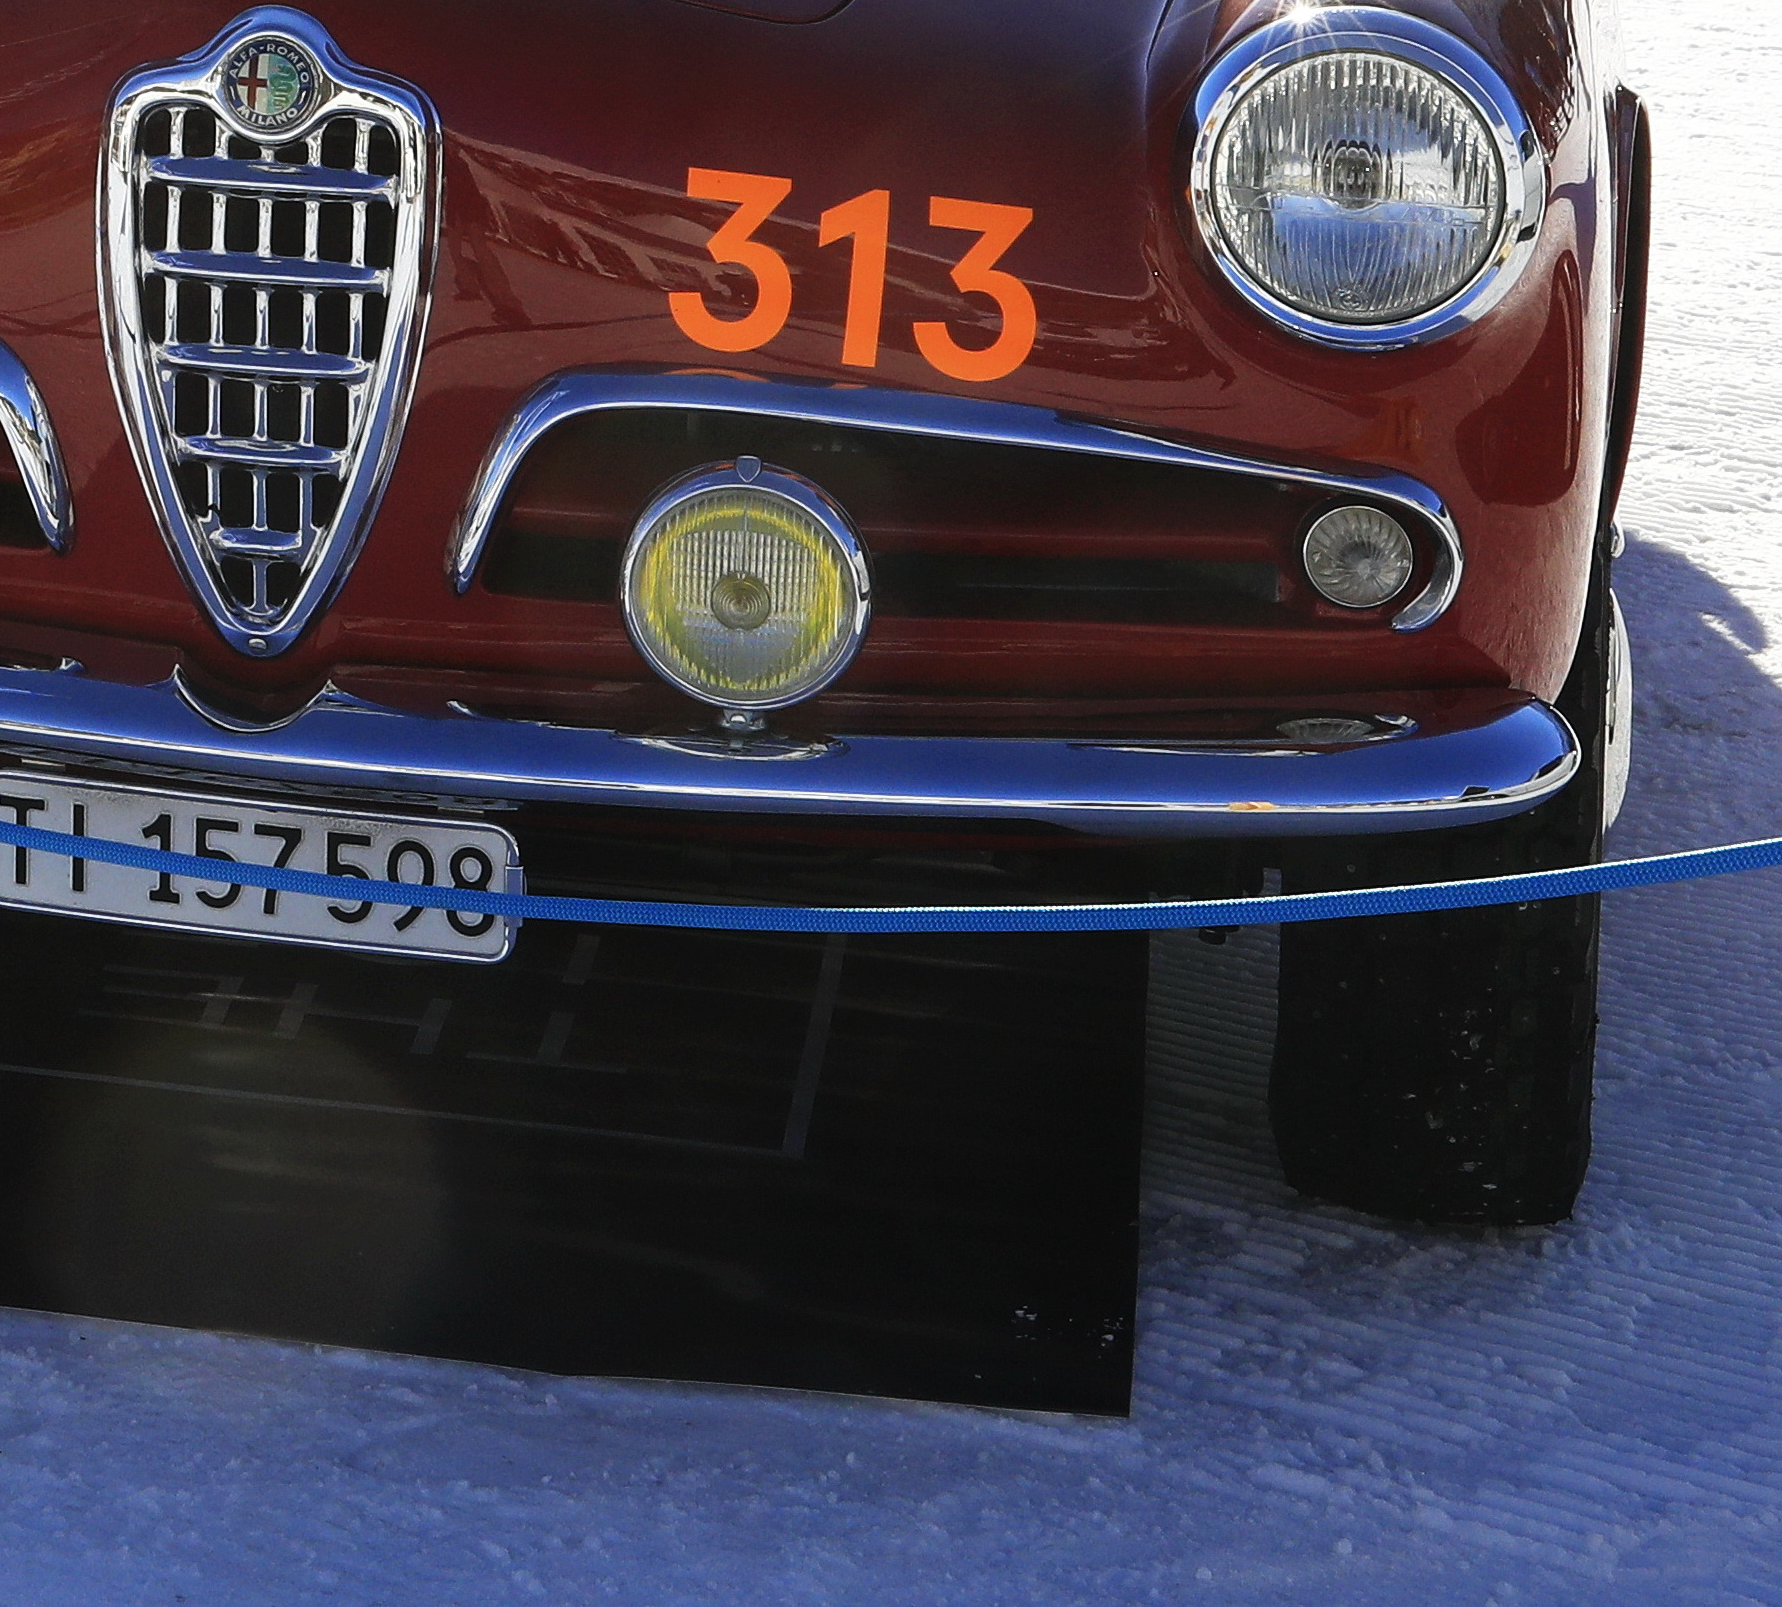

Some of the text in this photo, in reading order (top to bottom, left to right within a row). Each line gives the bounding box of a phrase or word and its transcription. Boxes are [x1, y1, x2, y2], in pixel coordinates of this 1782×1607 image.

[236, 103, 298, 126] MILANO
[668, 166, 1038, 383] 313
[140, 813, 303, 917] 157
[324, 831, 497, 936] 598
